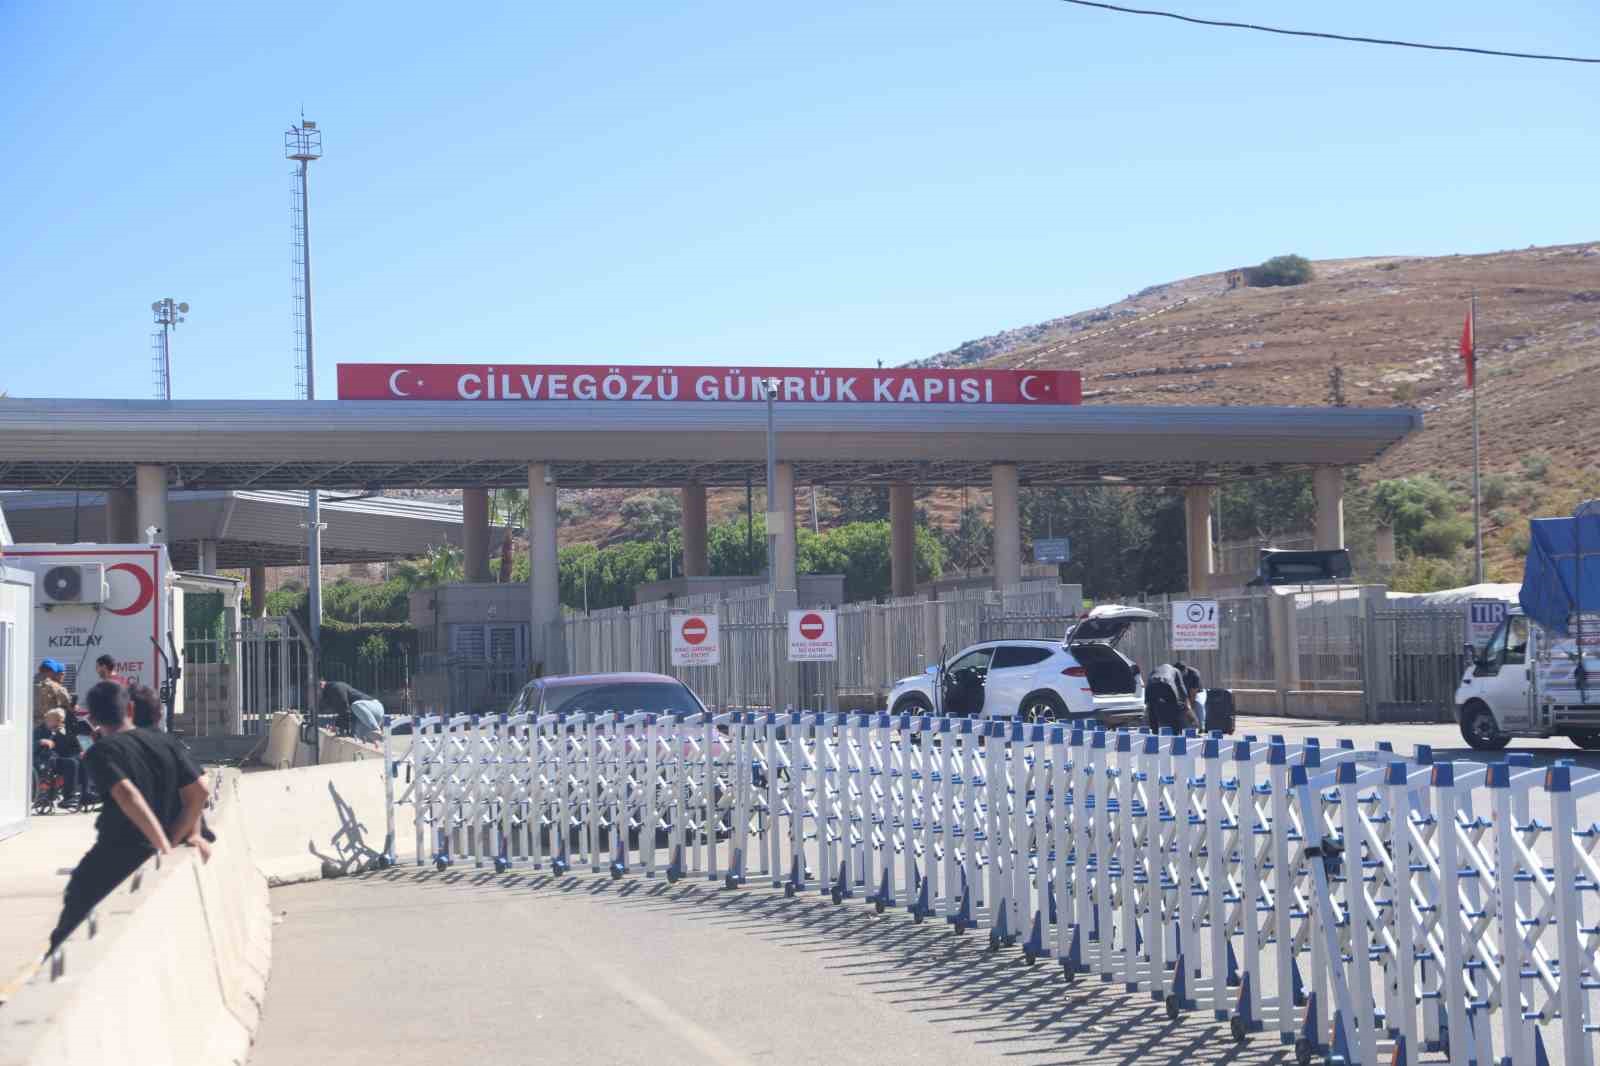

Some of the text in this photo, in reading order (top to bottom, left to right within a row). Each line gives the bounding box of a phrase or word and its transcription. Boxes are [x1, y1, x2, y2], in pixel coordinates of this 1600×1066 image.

[456, 367, 993, 404] CİLVEGÖZÜ GÜMRÜK KAPISI
[1472, 603, 1504, 622] TIR
[48, 635, 102, 648] KIZILAY
